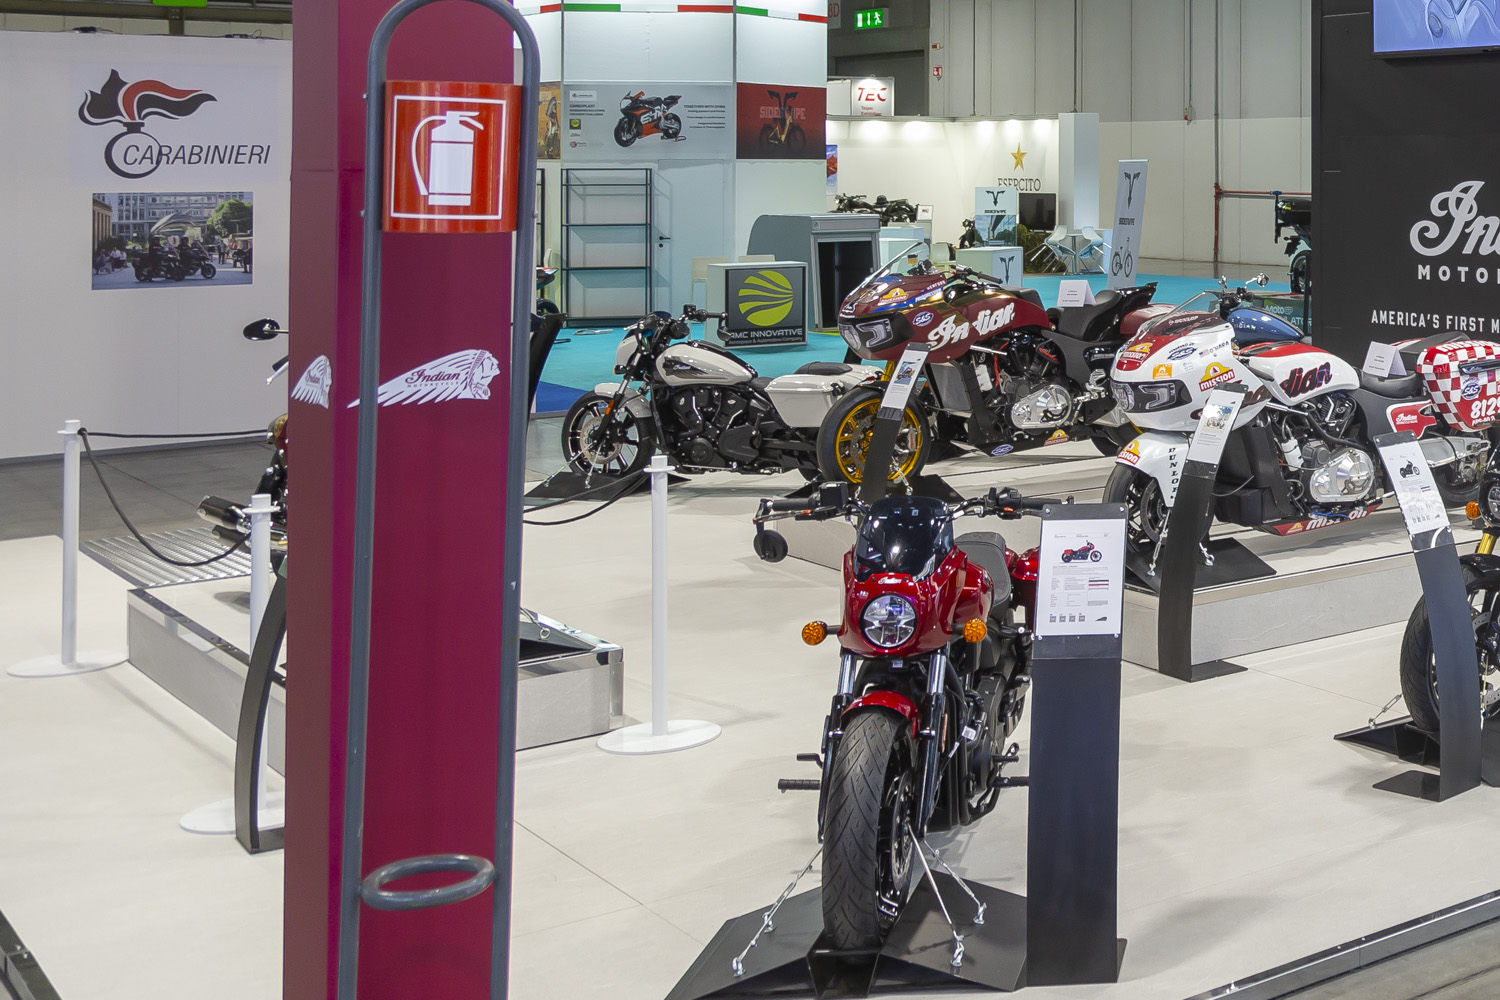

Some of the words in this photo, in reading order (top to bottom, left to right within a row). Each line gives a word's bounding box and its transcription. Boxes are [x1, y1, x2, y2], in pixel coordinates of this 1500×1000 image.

[857, 87, 888, 102] TEC
[123, 144, 271, 166] CARABINIERI
[1371, 309, 1440, 329] AMERICA'S
[1446, 315, 1485, 334] FIRST
[750, 328, 803, 338] INNOVATIVE
[405, 369, 460, 384] Indian
